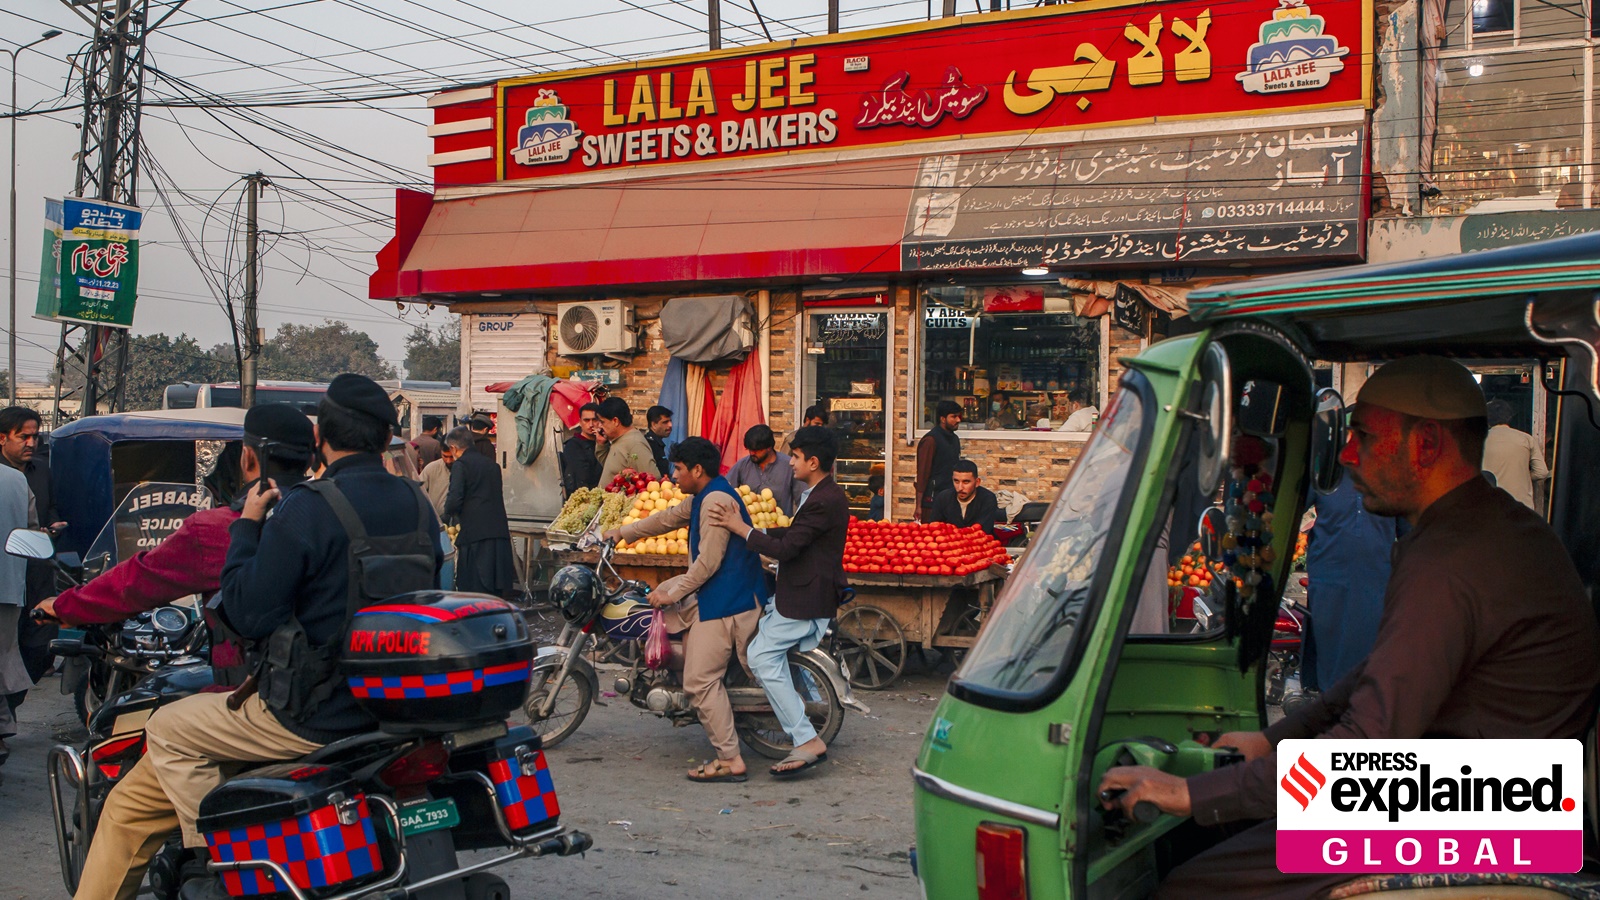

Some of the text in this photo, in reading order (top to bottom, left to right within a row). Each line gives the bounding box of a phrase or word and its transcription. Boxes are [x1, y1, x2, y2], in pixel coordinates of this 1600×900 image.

[1263, 62, 1317, 83] LALA JEE
[603, 53, 816, 126] LALA JEE
[1264, 83, 1288, 91] Sweets
[1296, 78, 1321, 88] Bakers
[582, 108, 837, 167] SWEETS & BAKERS
[528, 140, 561, 157] LALA JEE
[1217, 200, 1325, 219] 03333714444
[479, 322, 514, 331] GROUP
[350, 630, 431, 655] KPK POLICE
[400, 809, 449, 827] GAA 7933
